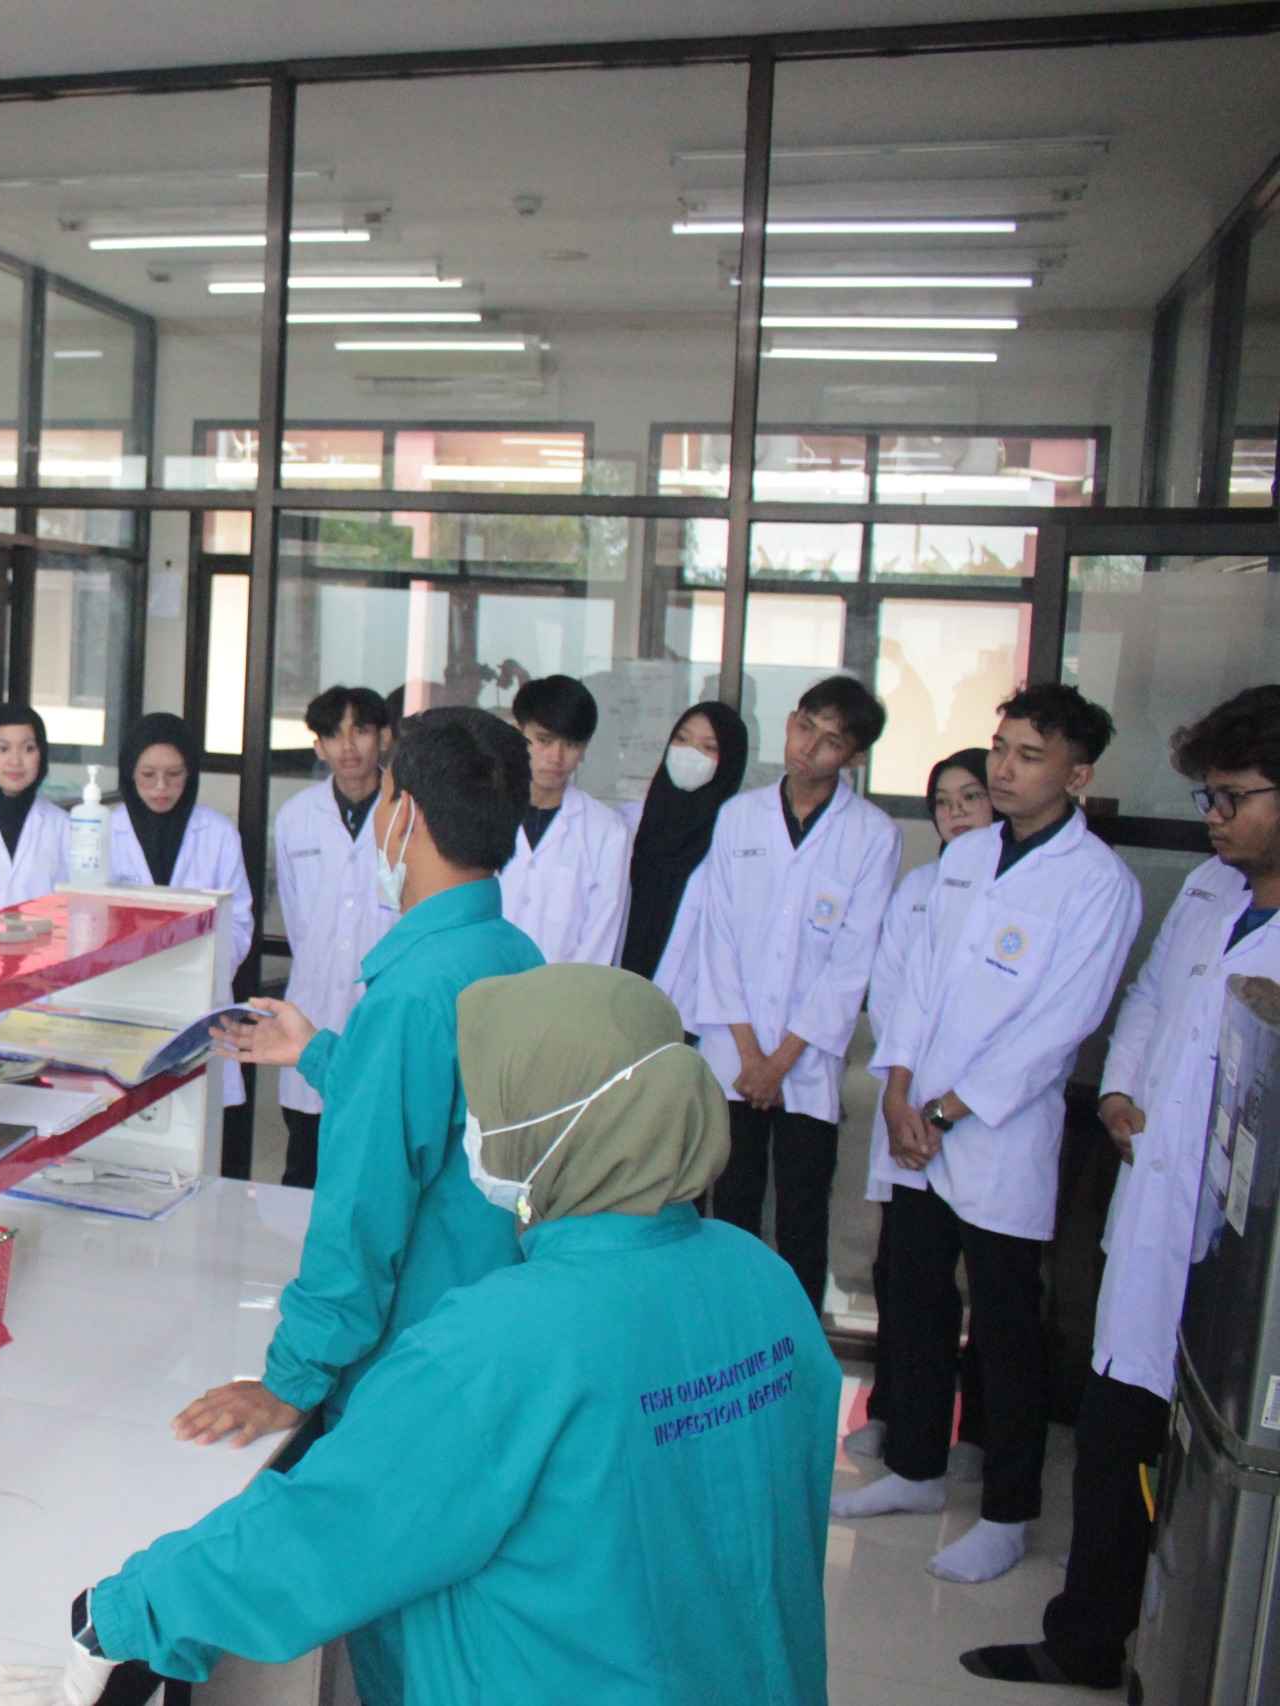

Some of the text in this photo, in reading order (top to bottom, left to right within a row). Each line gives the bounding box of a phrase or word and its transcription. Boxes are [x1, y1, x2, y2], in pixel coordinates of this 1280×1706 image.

[640, 1336, 795, 1415] FISH QUARANTINE AND
[654, 1370, 794, 1447] INSPECTION AGENCY
